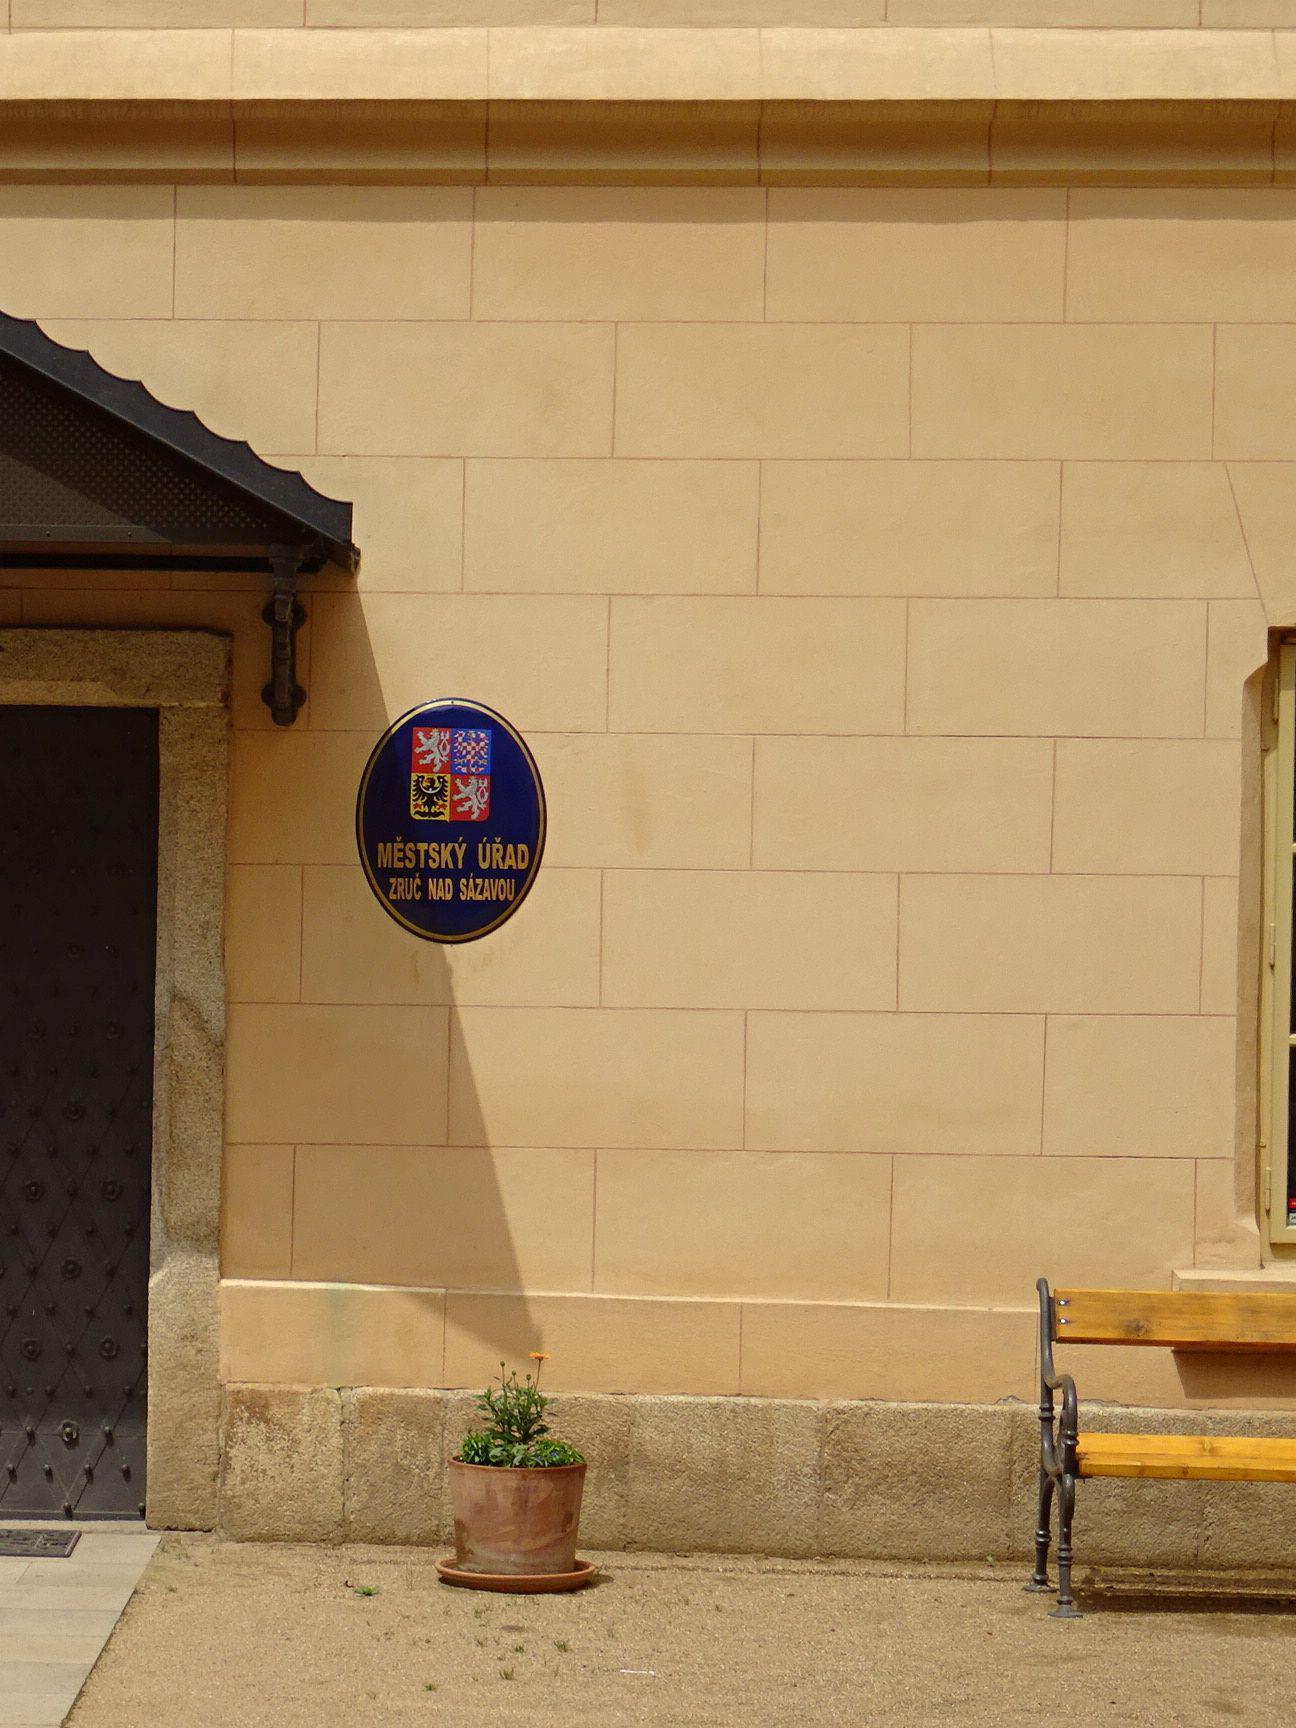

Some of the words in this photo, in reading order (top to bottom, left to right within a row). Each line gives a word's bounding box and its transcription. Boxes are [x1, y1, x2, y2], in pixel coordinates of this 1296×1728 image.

[377, 836, 467, 869] MĚSTSKÝ
[478, 837, 530, 869] ÚŘAD
[389, 873, 421, 900] ZRUČ
[428, 877, 453, 900] NAD
[459, 873, 516, 901] SÁZAVOU
